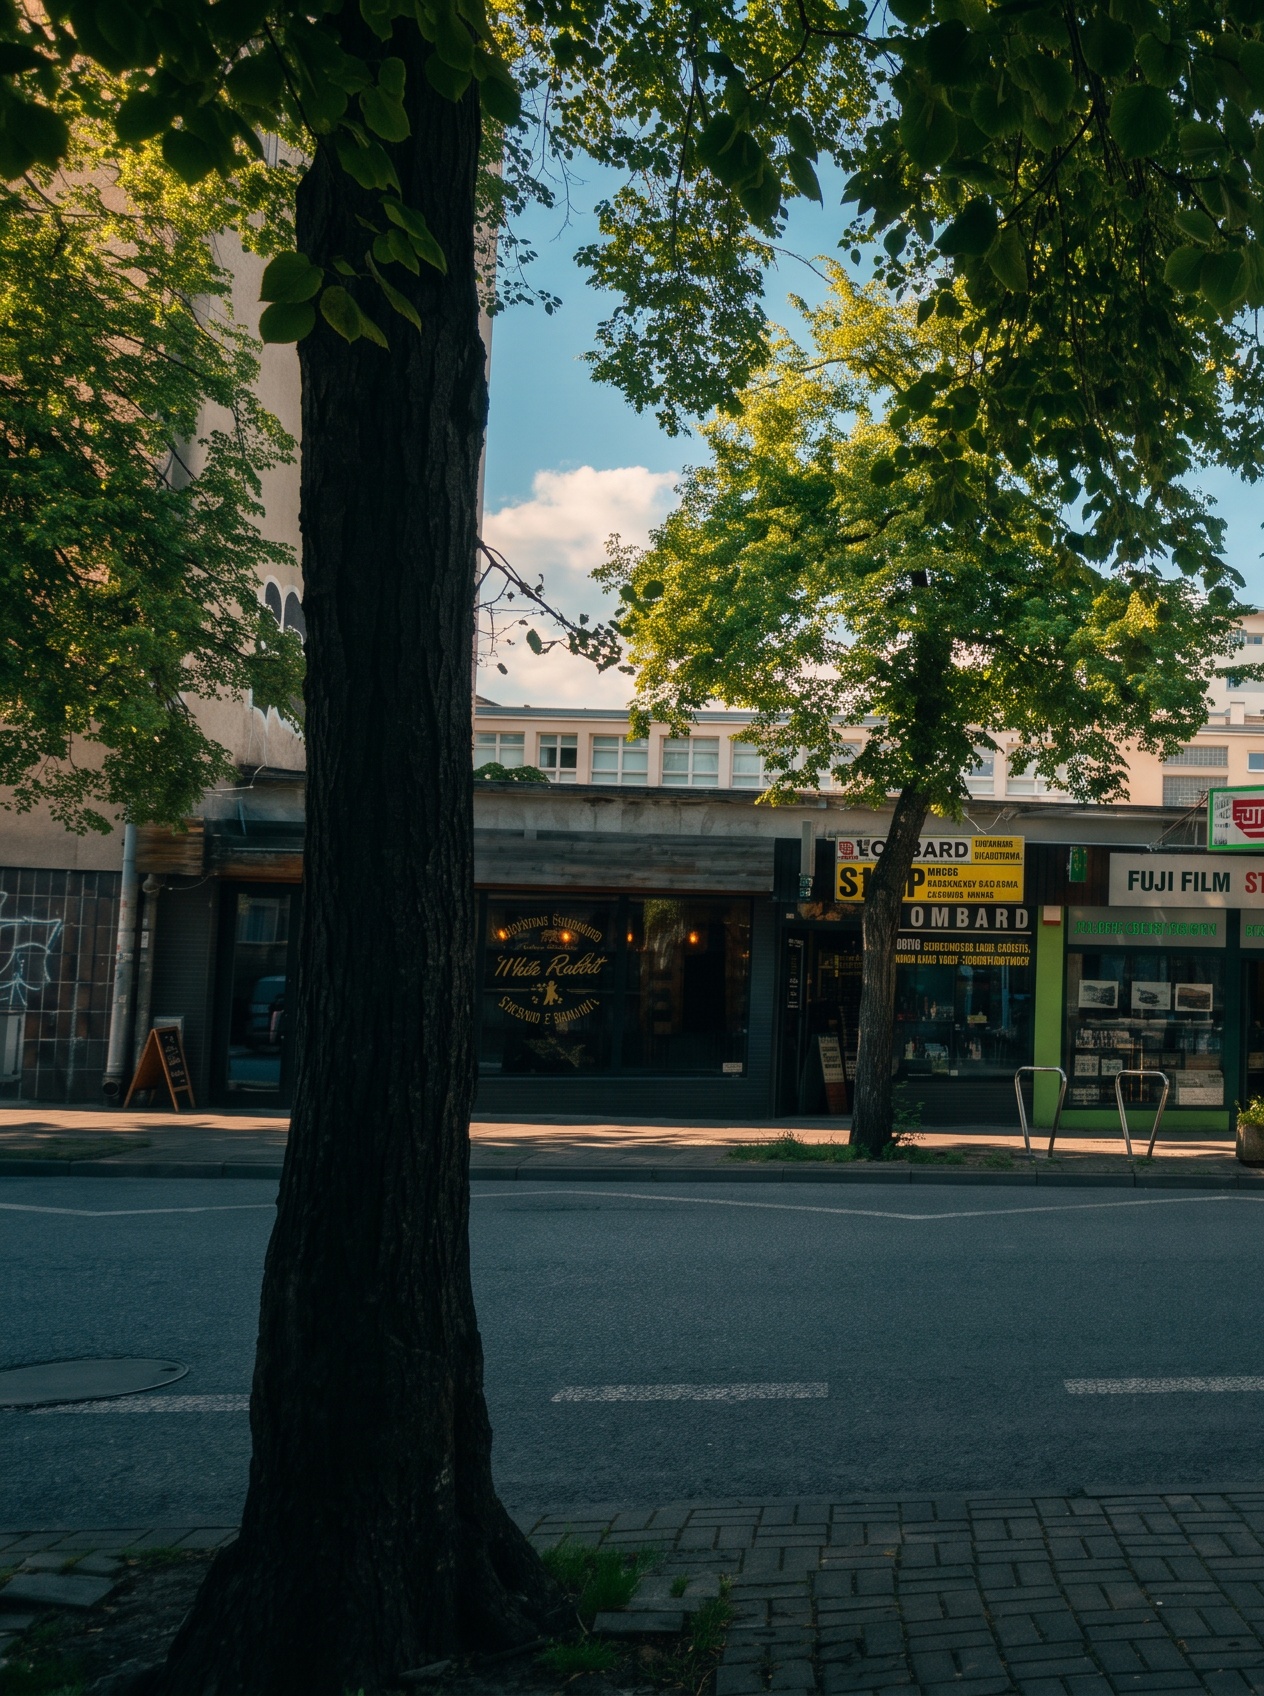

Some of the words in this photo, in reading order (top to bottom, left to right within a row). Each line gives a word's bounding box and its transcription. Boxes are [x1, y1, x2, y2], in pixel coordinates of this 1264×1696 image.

[1128, 870, 1174, 892] FUJI
[1181, 871, 1231, 893] FILM
[910, 906, 1029, 929] OMBARD
